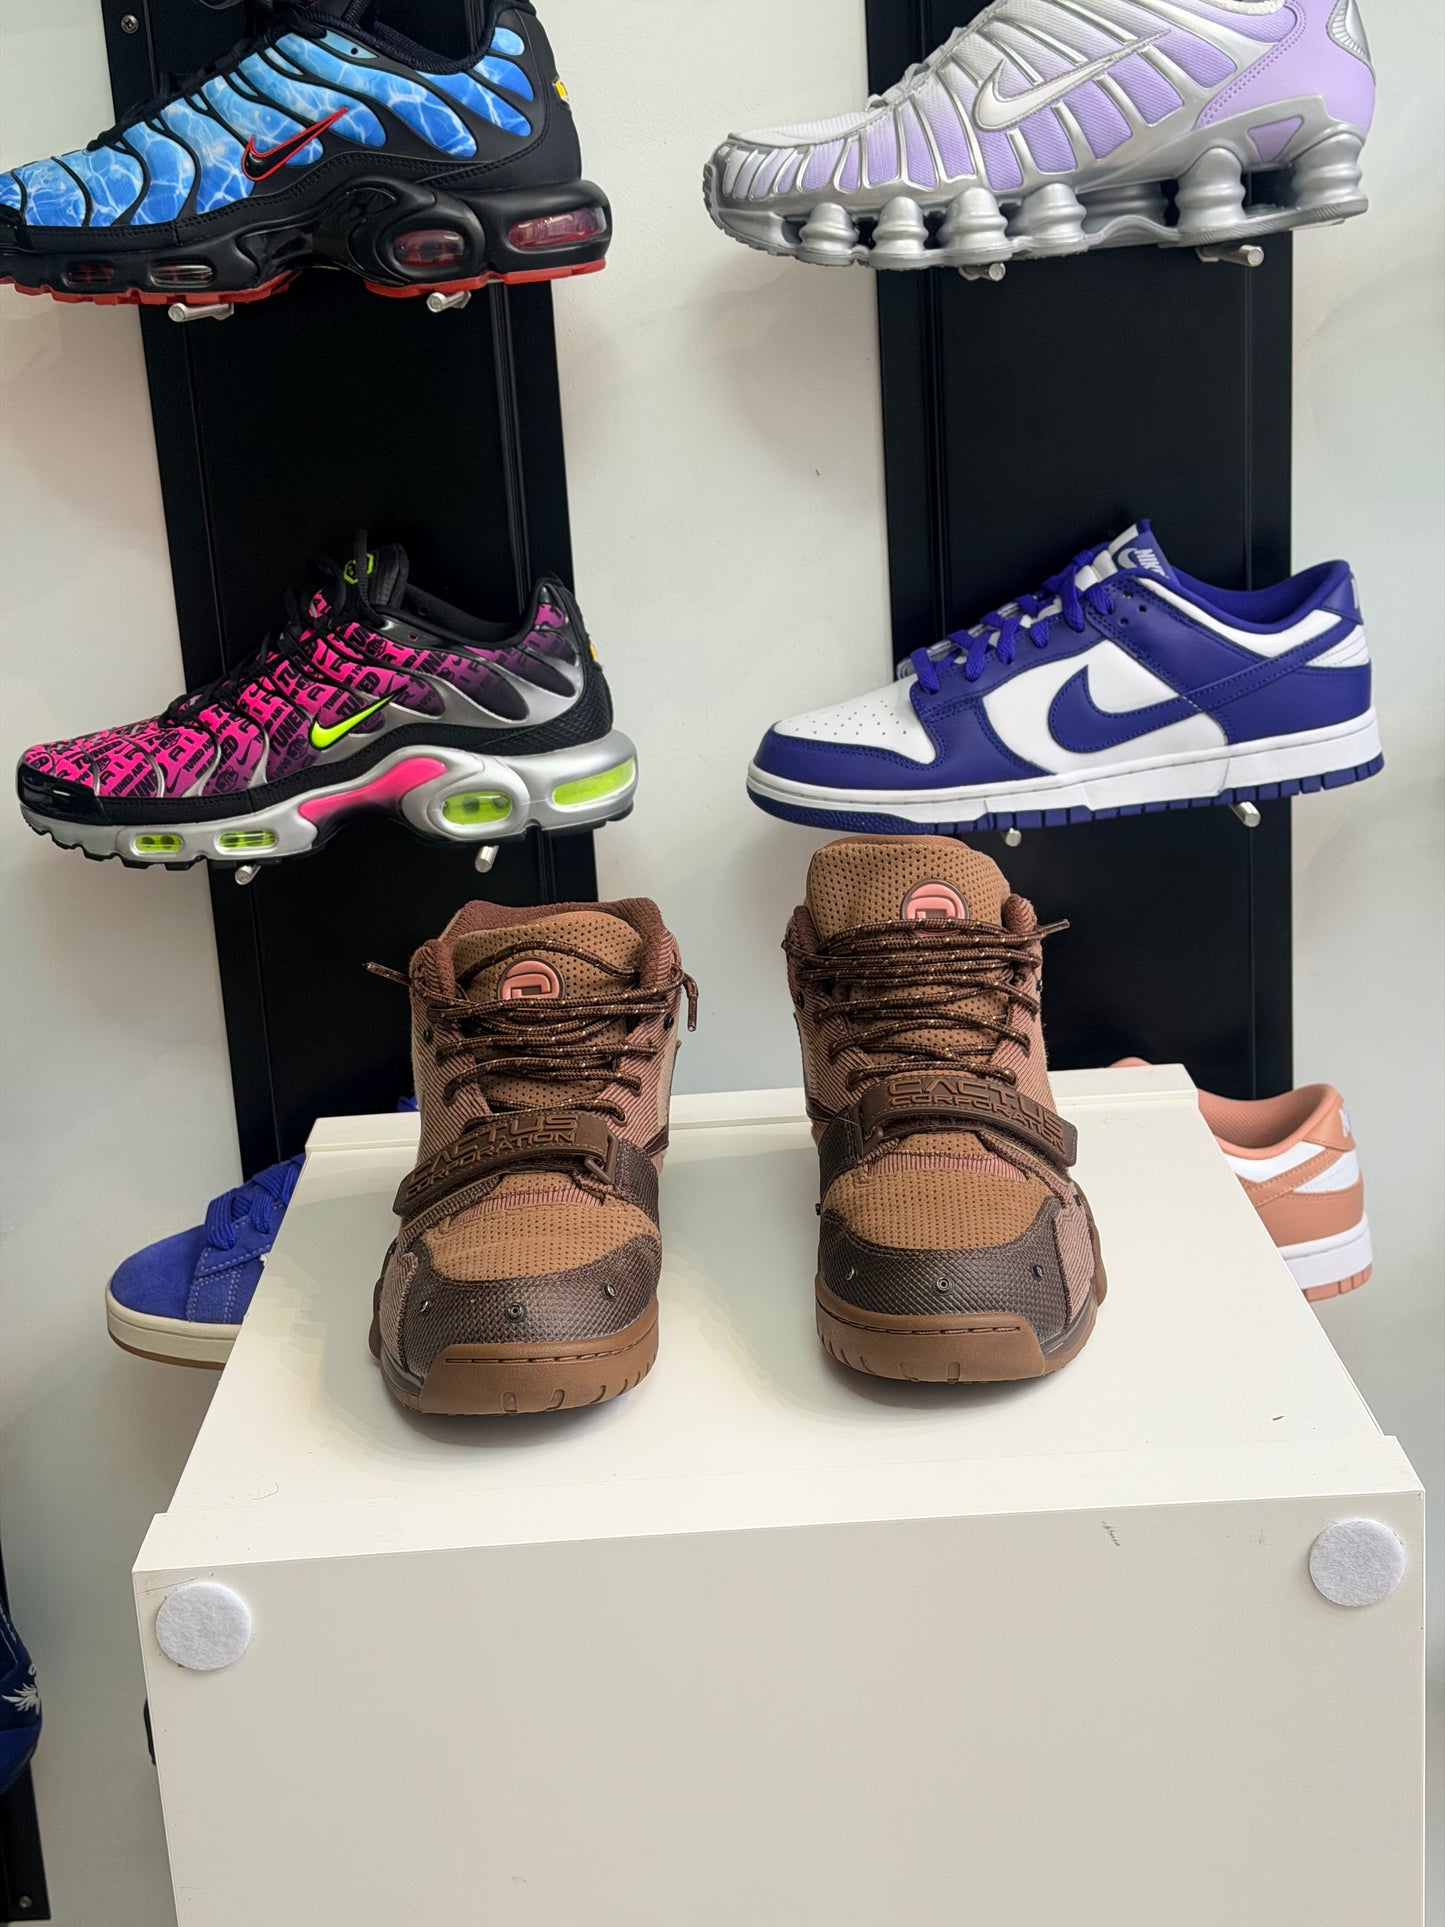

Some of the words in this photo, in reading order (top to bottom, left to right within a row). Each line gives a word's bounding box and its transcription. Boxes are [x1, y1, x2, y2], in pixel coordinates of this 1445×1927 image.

[887, 1077, 1064, 1139] CACTUS
[889, 1094, 1067, 1155] CORPORATION
[406, 1130, 575, 1199] CORPORATION
[411, 1112, 580, 1185] CACTUS
